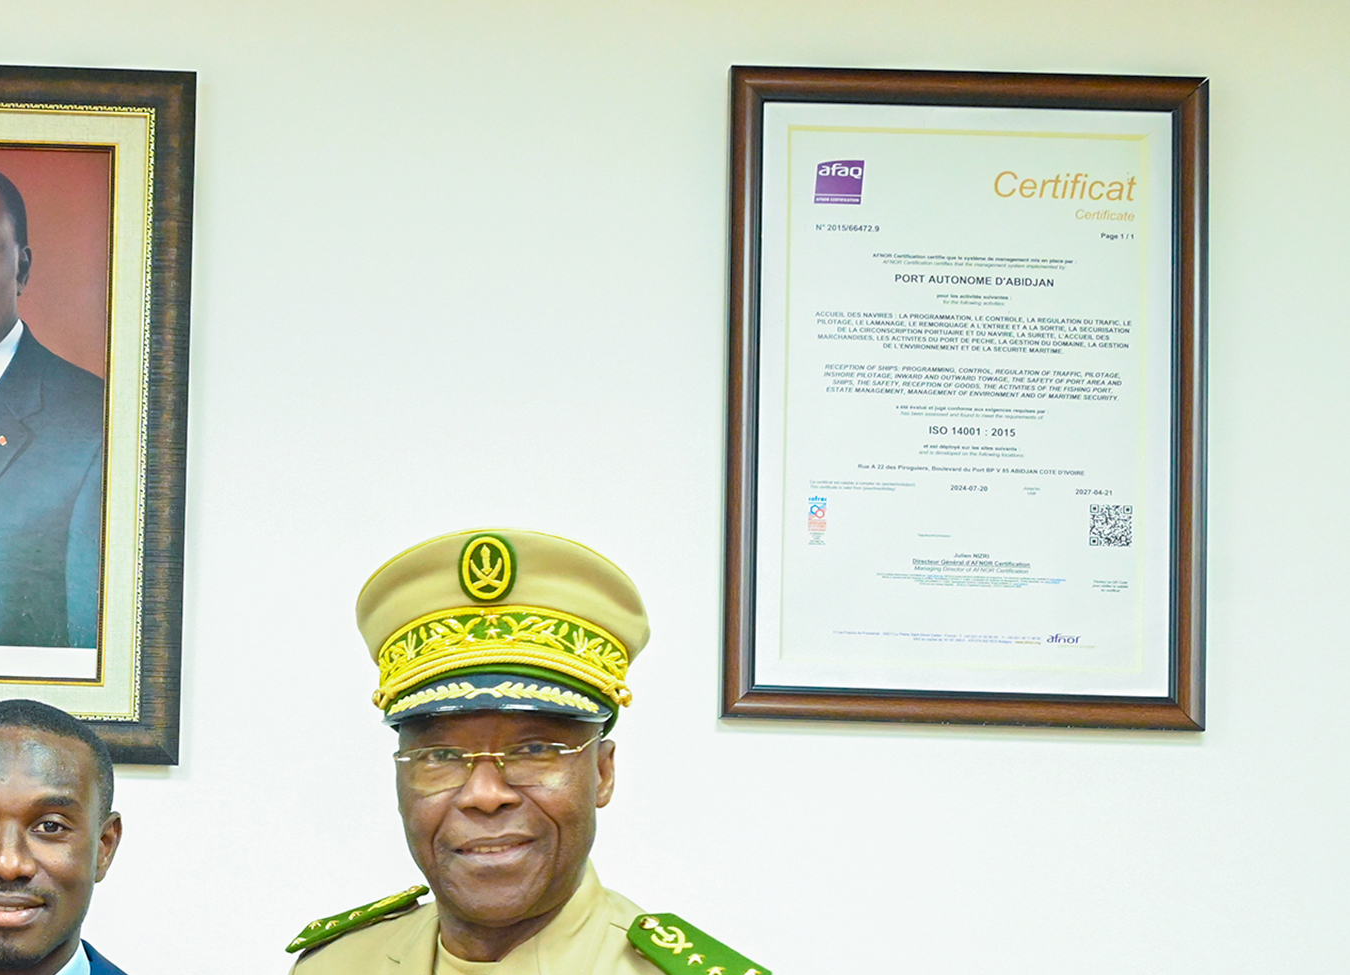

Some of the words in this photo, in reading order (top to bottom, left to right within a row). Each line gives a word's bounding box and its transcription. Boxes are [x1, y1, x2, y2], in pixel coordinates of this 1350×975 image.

[818, 163, 863, 179] afaq
[994, 170, 1136, 202] Certificat
[1075, 208, 1135, 222] Certificate
[827, 223, 880, 233] 2015/66472.9
[1100, 232, 1119, 241] Page
[894, 273, 925, 284] PORT
[928, 274, 993, 286] AUTONOME
[995, 276, 1055, 288] D'ABIDJAN
[815, 310, 845, 318] ACCUEIL
[909, 313, 974, 321] PROGRAMMATION,
[984, 315, 1026, 323] CONTROLE,
[1036, 317, 1083, 325] REGULATION
[1082, 318, 1094, 326] DU
[1094, 319, 1123, 327] TRAFIC,
[816, 318, 854, 326] PILOTAGE,
[865, 319, 907, 327] LAMANAGE,
[918, 321, 970, 329] REMORQUAGE
[1039, 324, 1068, 332] SORTIE,
[1078, 326, 1131, 334] SECURISATION
[858, 327, 924, 335] CIRCONSCRIPTION
[923, 328, 965, 336] PORTUAIRE
[987, 330, 1016, 338] NAVIRE,
[1057, 333, 1095, 341] L'ACCUEIL
[817, 333, 875, 341] MARCHANDISES,
[890, 335, 927, 343] ACTIVITES
[971, 337, 997, 345] PECHE,
[1052, 340, 1087, 348] DOMAINE,
[1098, 341, 1130, 350] GESTION
[893, 343, 960, 351] L'ENVIRONNEMENT
[992, 346, 1028, 354] SECURITE
[1028, 347, 1064, 355] MARITIME.
[823, 371, 855, 379] INSHORE
[940, 374, 977, 382] OUTWARD
[978, 375, 1010, 383] TOWAGE,
[854, 387, 906, 395] MANAGEMENT,
[907, 388, 957, 396] MANAGEMENT
[969, 390, 1019, 398] ENVIRONMENT
[1083, 394, 1121, 402] SECURITY.
[928, 425, 949, 436] ISO
[952, 426, 981, 437] 14001
[991, 427, 1016, 438] 2015
[949, 484, 989, 492] 2024-07-20
[1074, 488, 1113, 496] 2027-04-21
[1046, 633, 1081, 645] afnor
